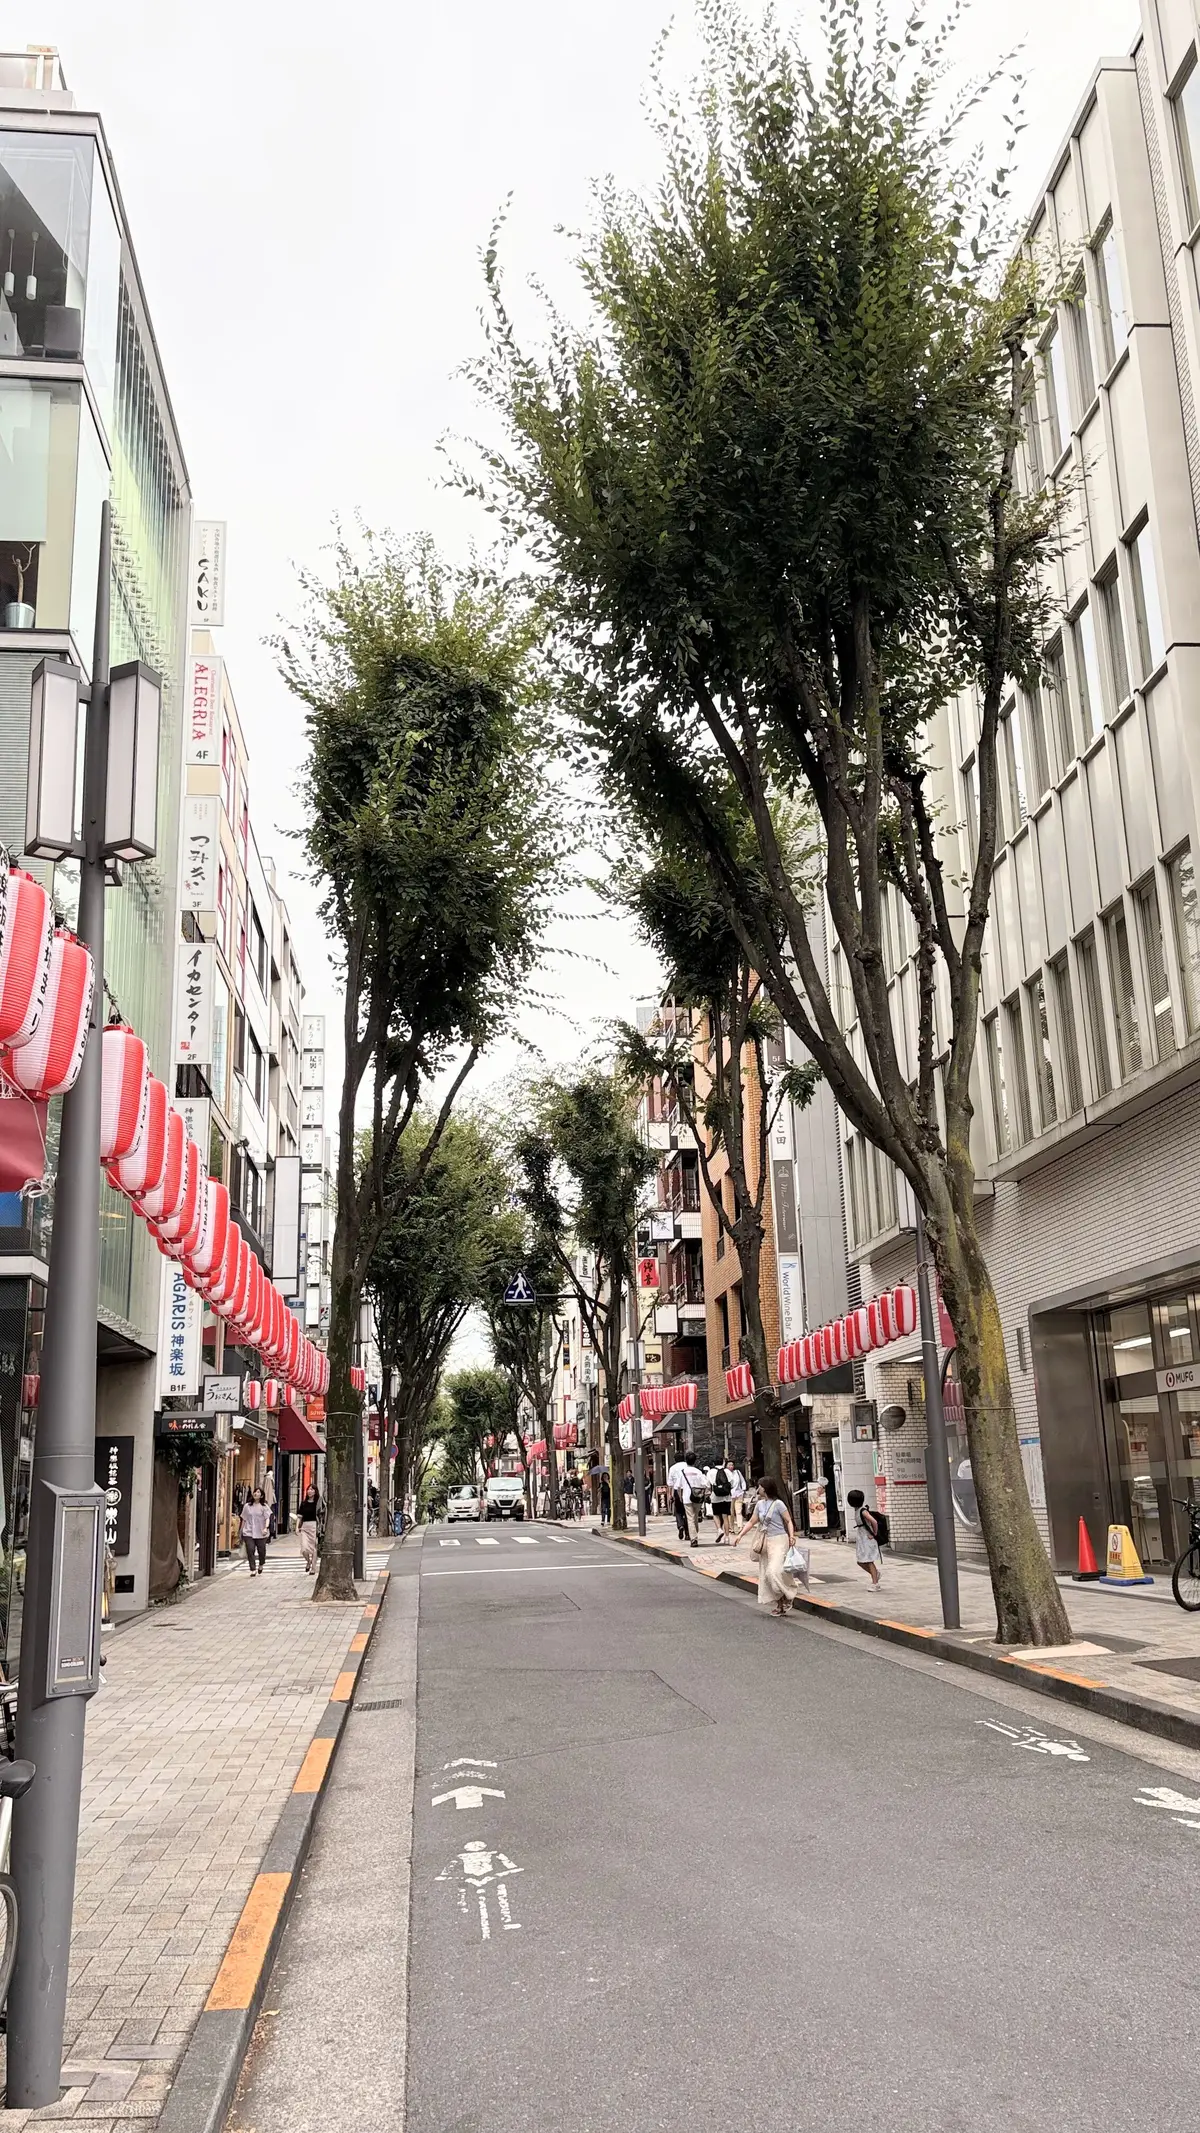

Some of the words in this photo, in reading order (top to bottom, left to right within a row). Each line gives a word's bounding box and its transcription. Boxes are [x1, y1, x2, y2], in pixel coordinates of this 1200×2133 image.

[196, 558, 210, 611] SAKU
[192, 662, 209, 741] ALEGRIA
[195, 750, 209, 759] 4F
[185, 949, 203, 1040] イカセンター
[782, 1271, 791, 1295] World
[171, 1272, 187, 1330] AGARIS
[784, 1296, 792, 1316] Wine
[169, 1333, 186, 1376] 神楽坂
[170, 1384, 187, 1392] B1F
[1175, 1371, 1194, 1384] MUFG
